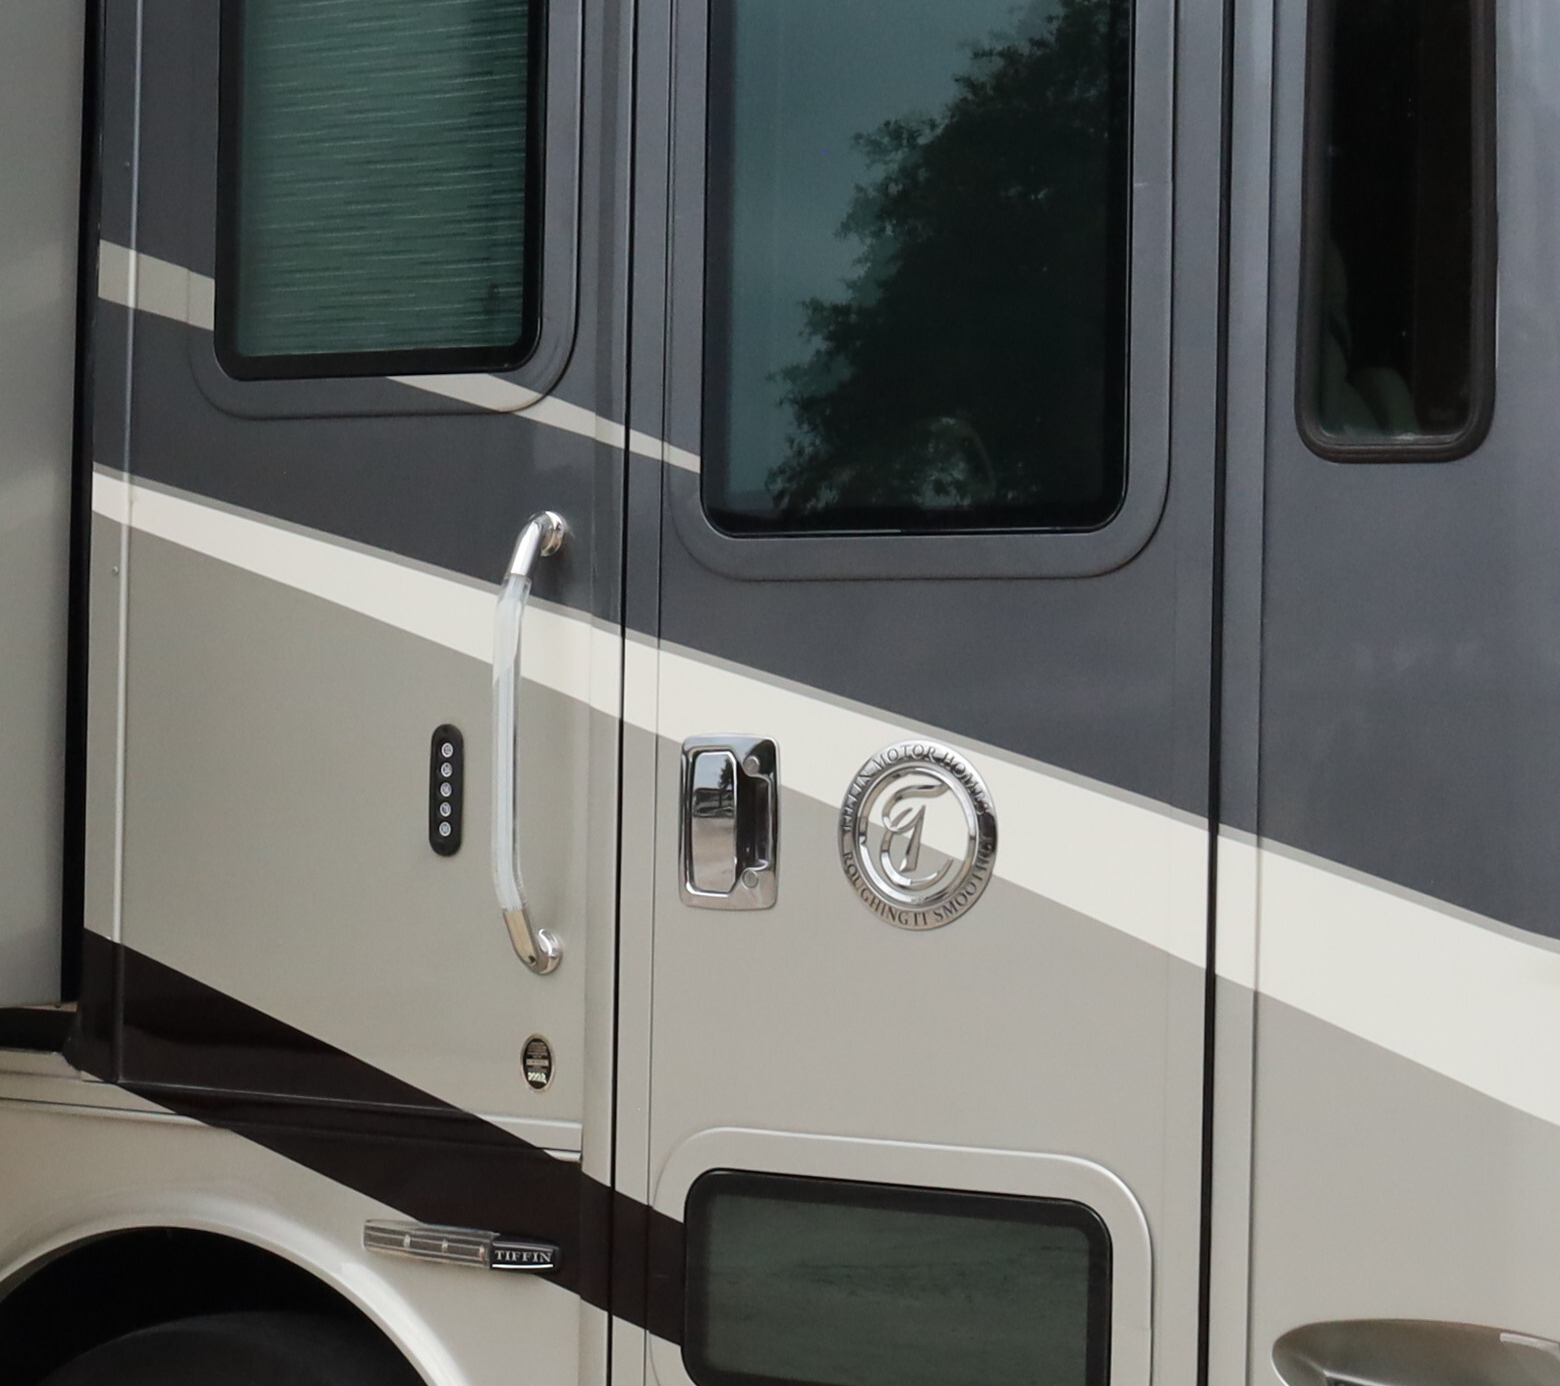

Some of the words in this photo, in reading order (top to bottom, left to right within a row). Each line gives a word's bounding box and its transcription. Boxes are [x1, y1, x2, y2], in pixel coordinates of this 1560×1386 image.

[873, 744, 936, 771] MOTOR
[943, 751, 991, 816] HOMES
[842, 851, 910, 926] ROUGHING
[913, 911, 929, 926] IT
[494, 1249, 552, 1264] TIFFIN
